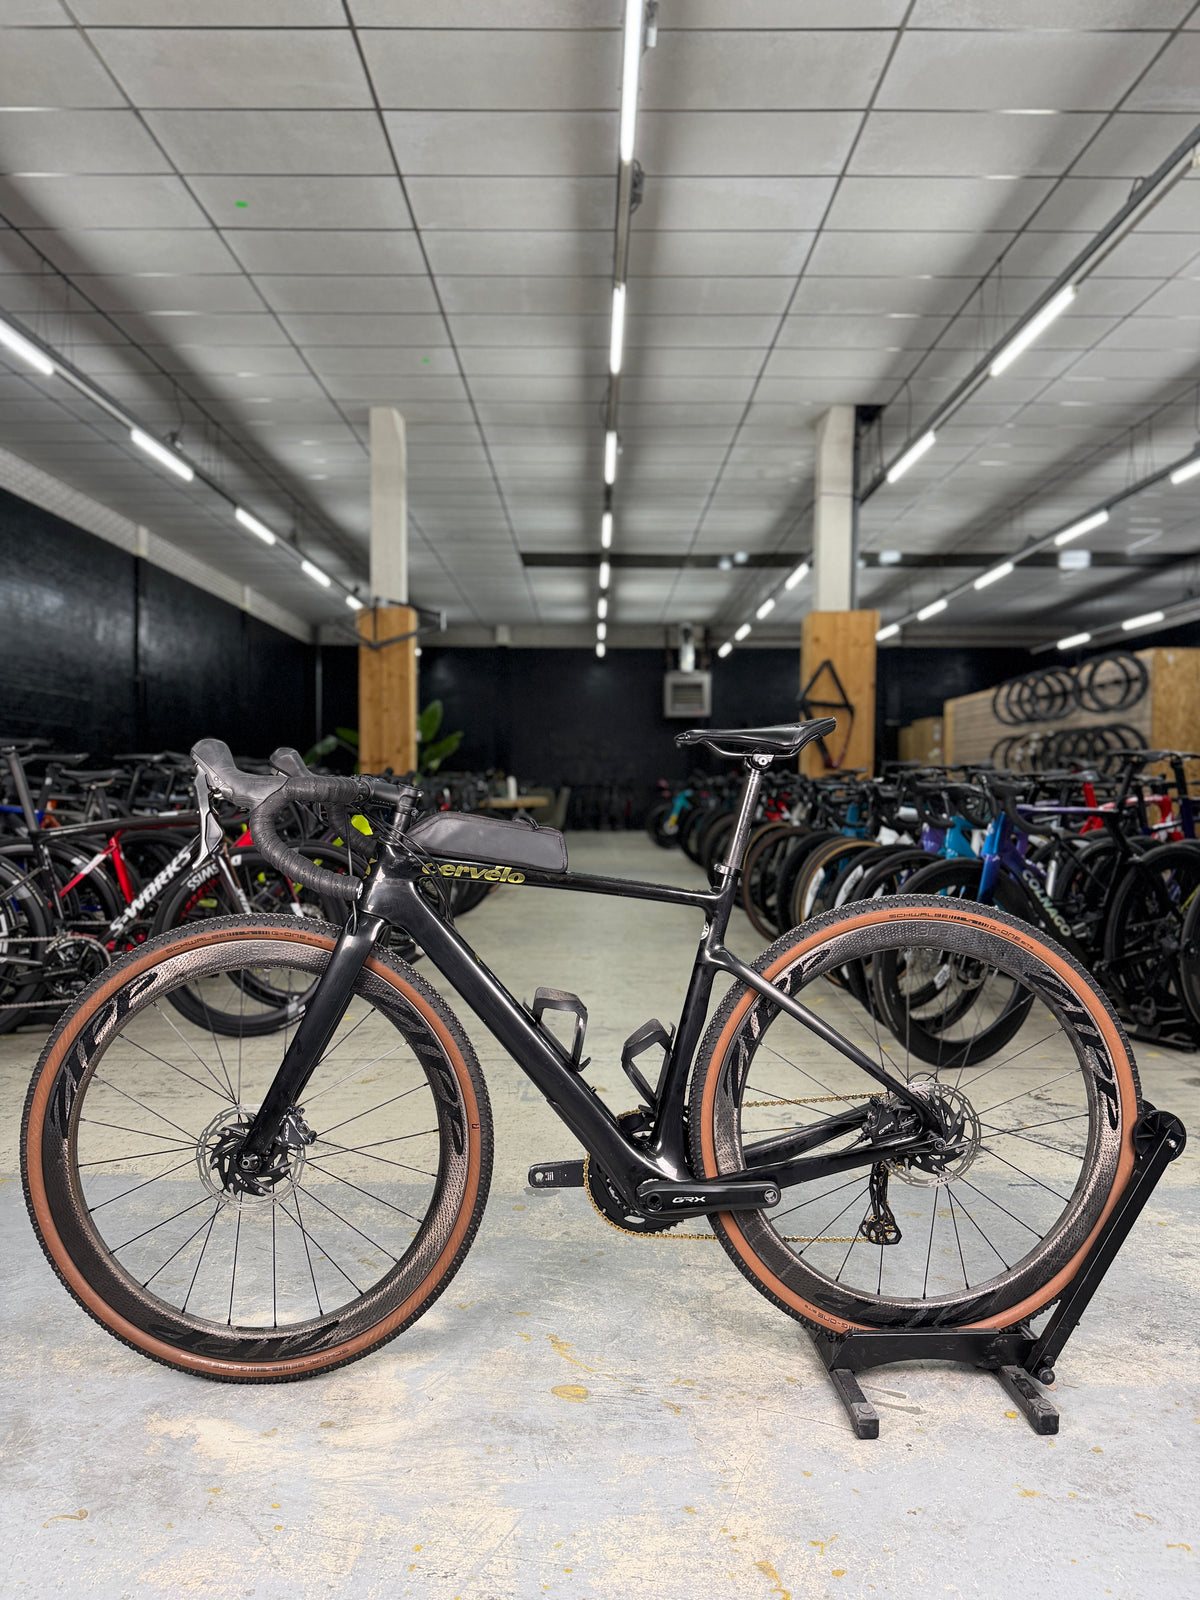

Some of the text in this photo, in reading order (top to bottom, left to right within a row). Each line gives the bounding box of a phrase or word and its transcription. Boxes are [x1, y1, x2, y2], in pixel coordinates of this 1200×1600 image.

[109, 847, 192, 938] S-WORKS
[1022, 869, 1072, 937] COLNAGO
[165, 932, 227, 953] SCHWALBE
[271, 930, 307, 940] G-ONE
[990, 925, 1021, 942] G-ONE
[672, 1196, 706, 1204] GRX
